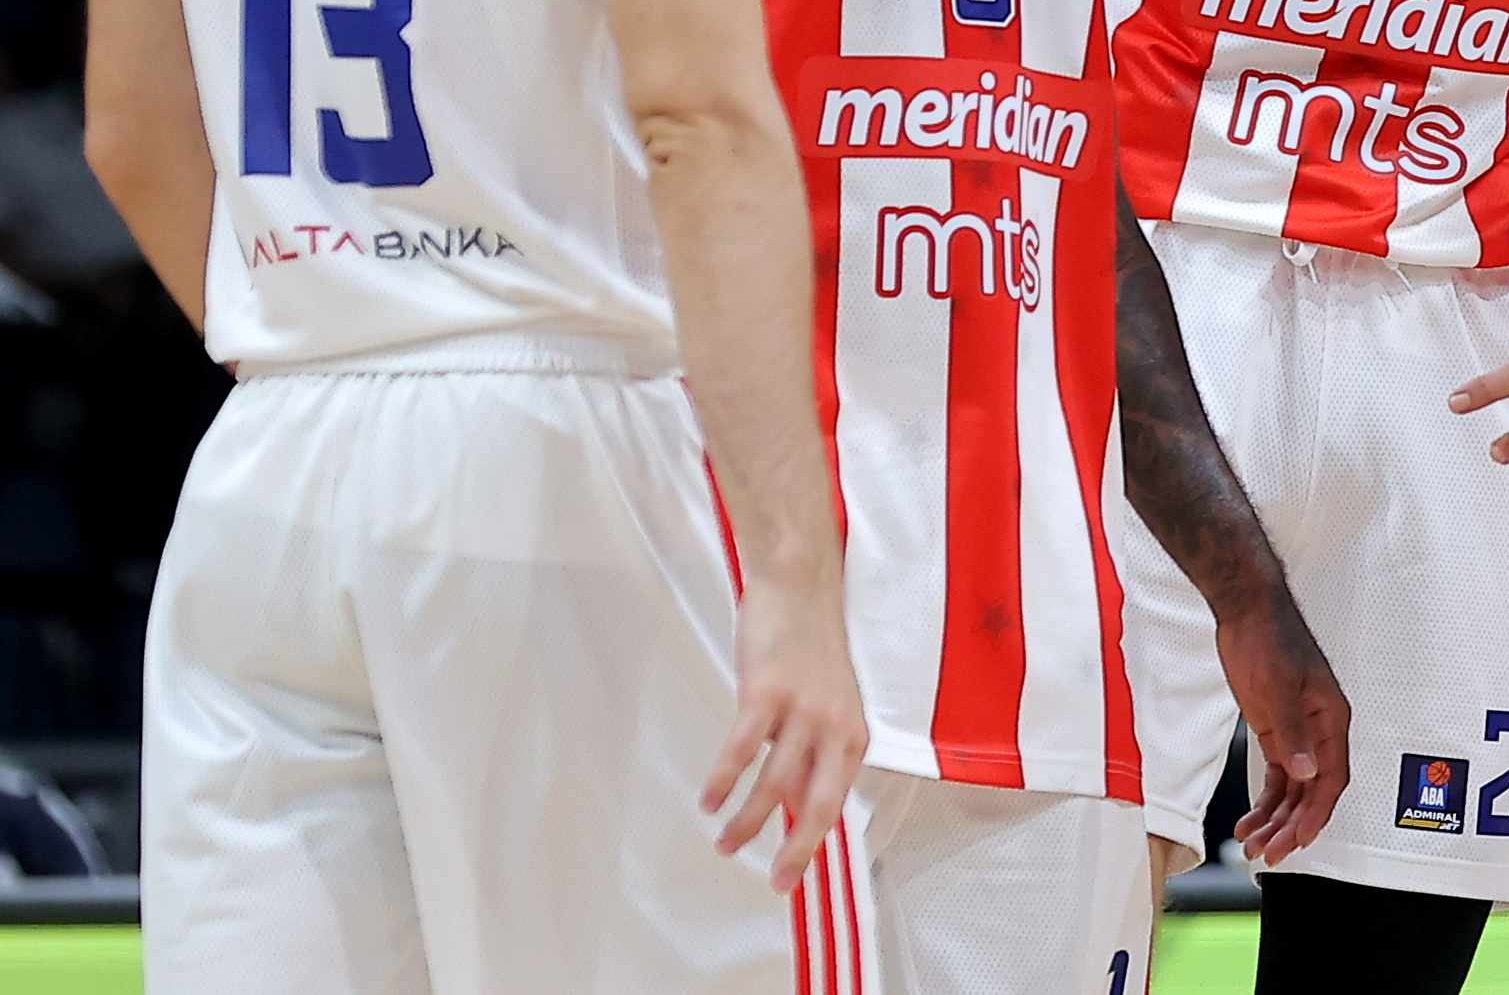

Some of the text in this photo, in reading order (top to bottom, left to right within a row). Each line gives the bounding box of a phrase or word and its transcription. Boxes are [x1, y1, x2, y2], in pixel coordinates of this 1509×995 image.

[816, 70, 1090, 169] meridian
[1227, 69, 1468, 185] mts
[875, 196, 1041, 313] mts
[1403, 808, 1460, 823] ADMIRAL
[1420, 786, 1444, 806] ABA
